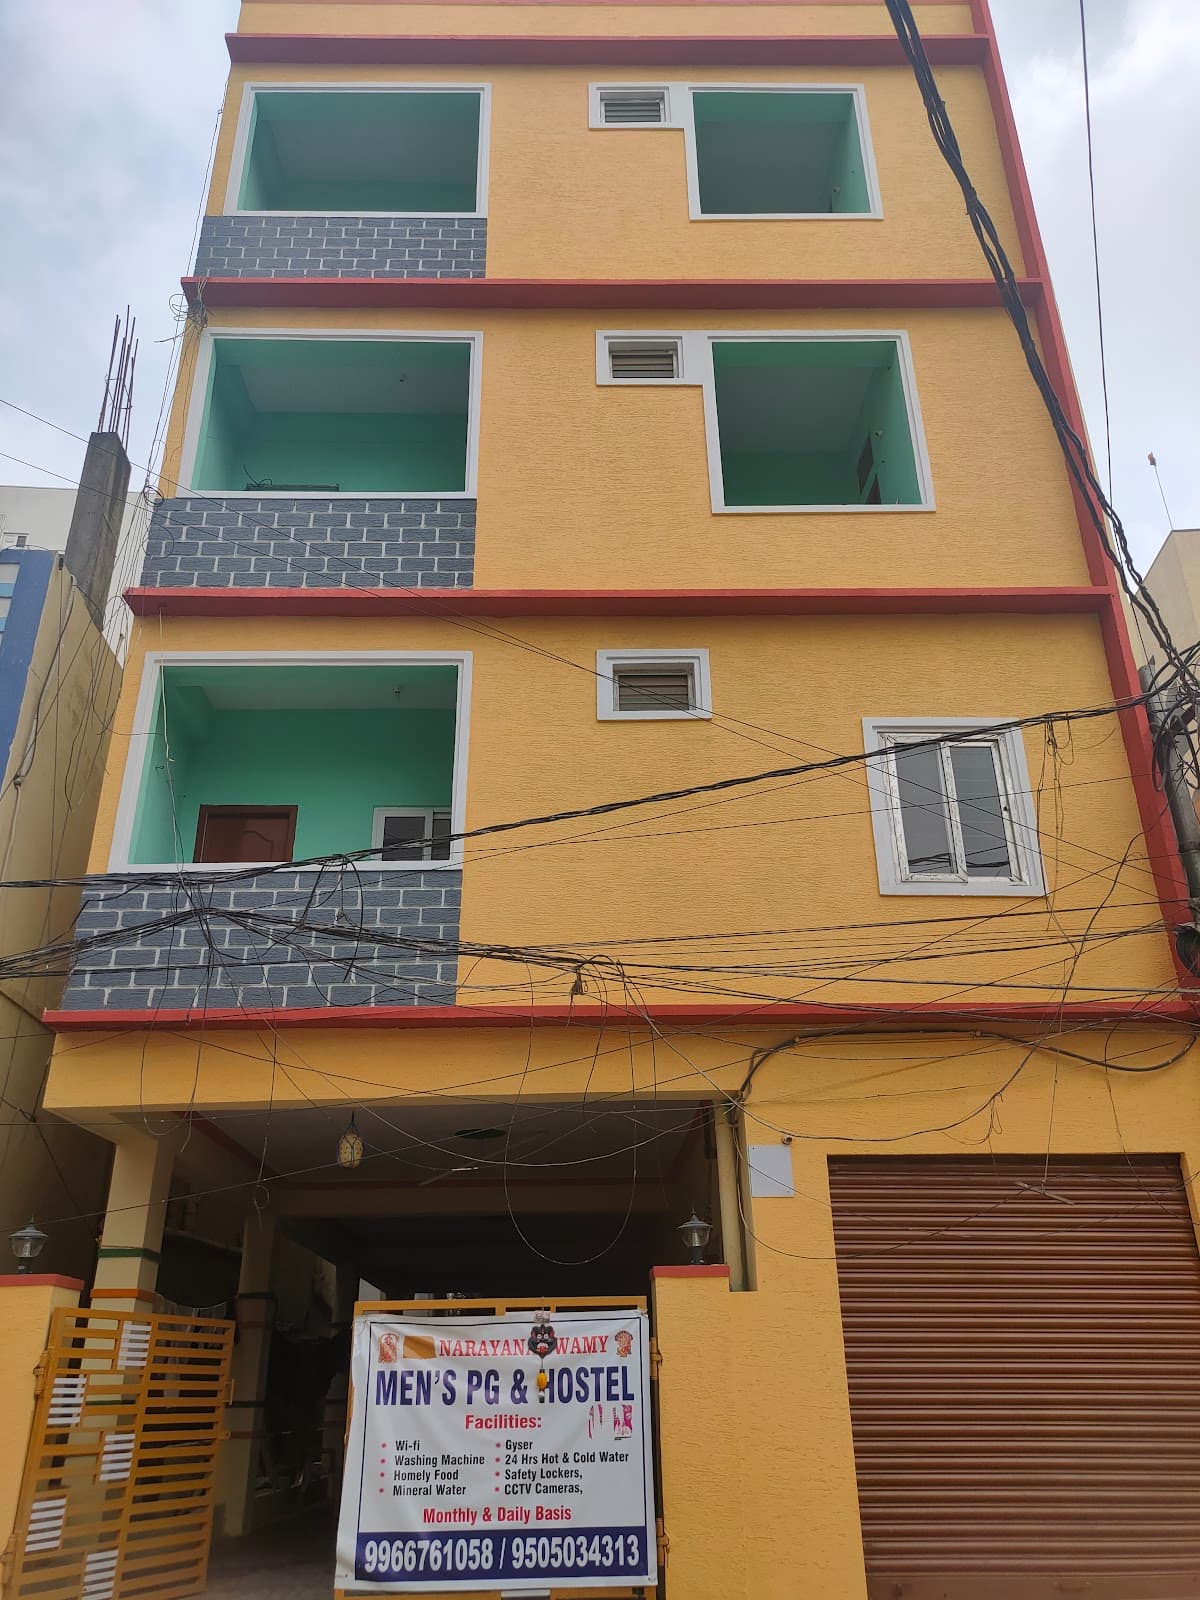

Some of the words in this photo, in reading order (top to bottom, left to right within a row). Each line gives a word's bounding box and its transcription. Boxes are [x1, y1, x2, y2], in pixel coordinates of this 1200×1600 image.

[439, 1339, 539, 1357] NARAYAN
[546, 1335, 609, 1355] WAMY
[376, 1369, 457, 1406] MEN'S
[466, 1369, 500, 1405] PG
[510, 1368, 528, 1404] &
[465, 1413, 542, 1429] Facilities:
[395, 1440, 421, 1451] Wi-fi
[505, 1439, 533, 1453] Gyser
[395, 1454, 438, 1468] Washing
[441, 1454, 485, 1465] Machine
[505, 1454, 518, 1465] 24
[521, 1453, 538, 1465] Hrs
[541, 1453, 559, 1464] Hot
[562, 1452, 570, 1463] &
[573, 1452, 596, 1463] Cold
[599, 1451, 630, 1462] Water
[393, 1470, 431, 1482] Homely
[434, 1470, 459, 1481] Food
[504, 1468, 537, 1481] Safety
[540, 1468, 583, 1480] Lockers,
[393, 1485, 432, 1496] Mineral
[436, 1484, 467, 1495] Water
[504, 1483, 532, 1495] CCTV
[535, 1483, 583, 1495] Cameras,
[423, 1506, 477, 1526] Monthly
[482, 1507, 493, 1522] &
[497, 1505, 531, 1524] Daily
[535, 1504, 572, 1521] Basis
[364, 1537, 494, 1573] 9966761058
[499, 1536, 507, 1570] /
[511, 1534, 640, 1569] 9505034313
